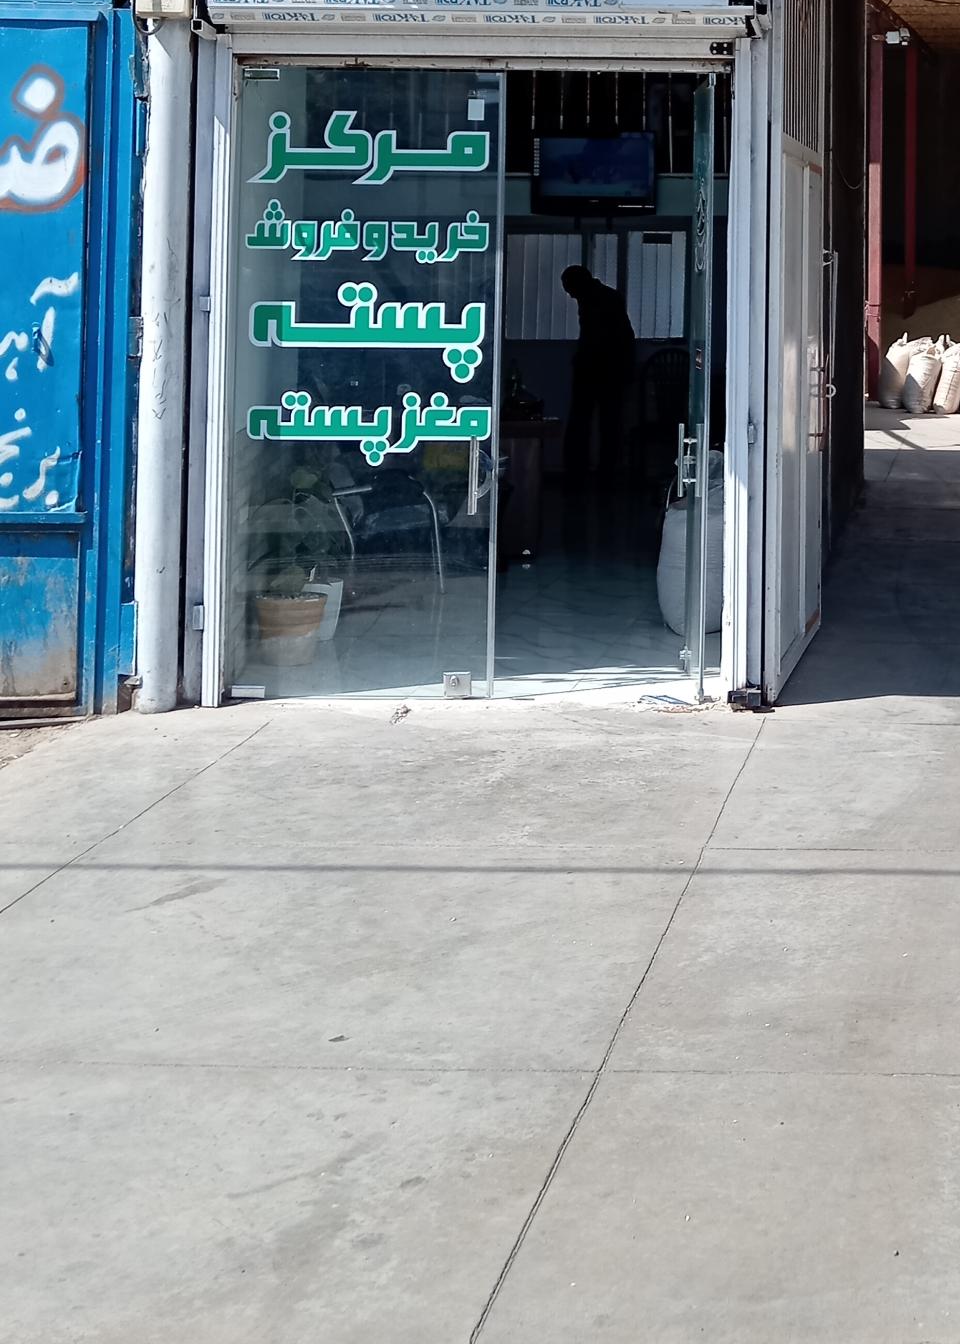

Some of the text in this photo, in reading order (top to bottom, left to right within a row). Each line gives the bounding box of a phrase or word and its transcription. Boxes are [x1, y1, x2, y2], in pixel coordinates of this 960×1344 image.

[246, 109, 491, 185] مرکز
[391, 210, 490, 263] خرید
[248, 281, 487, 384] پسته
[246, 391, 492, 467] مغز پسته
